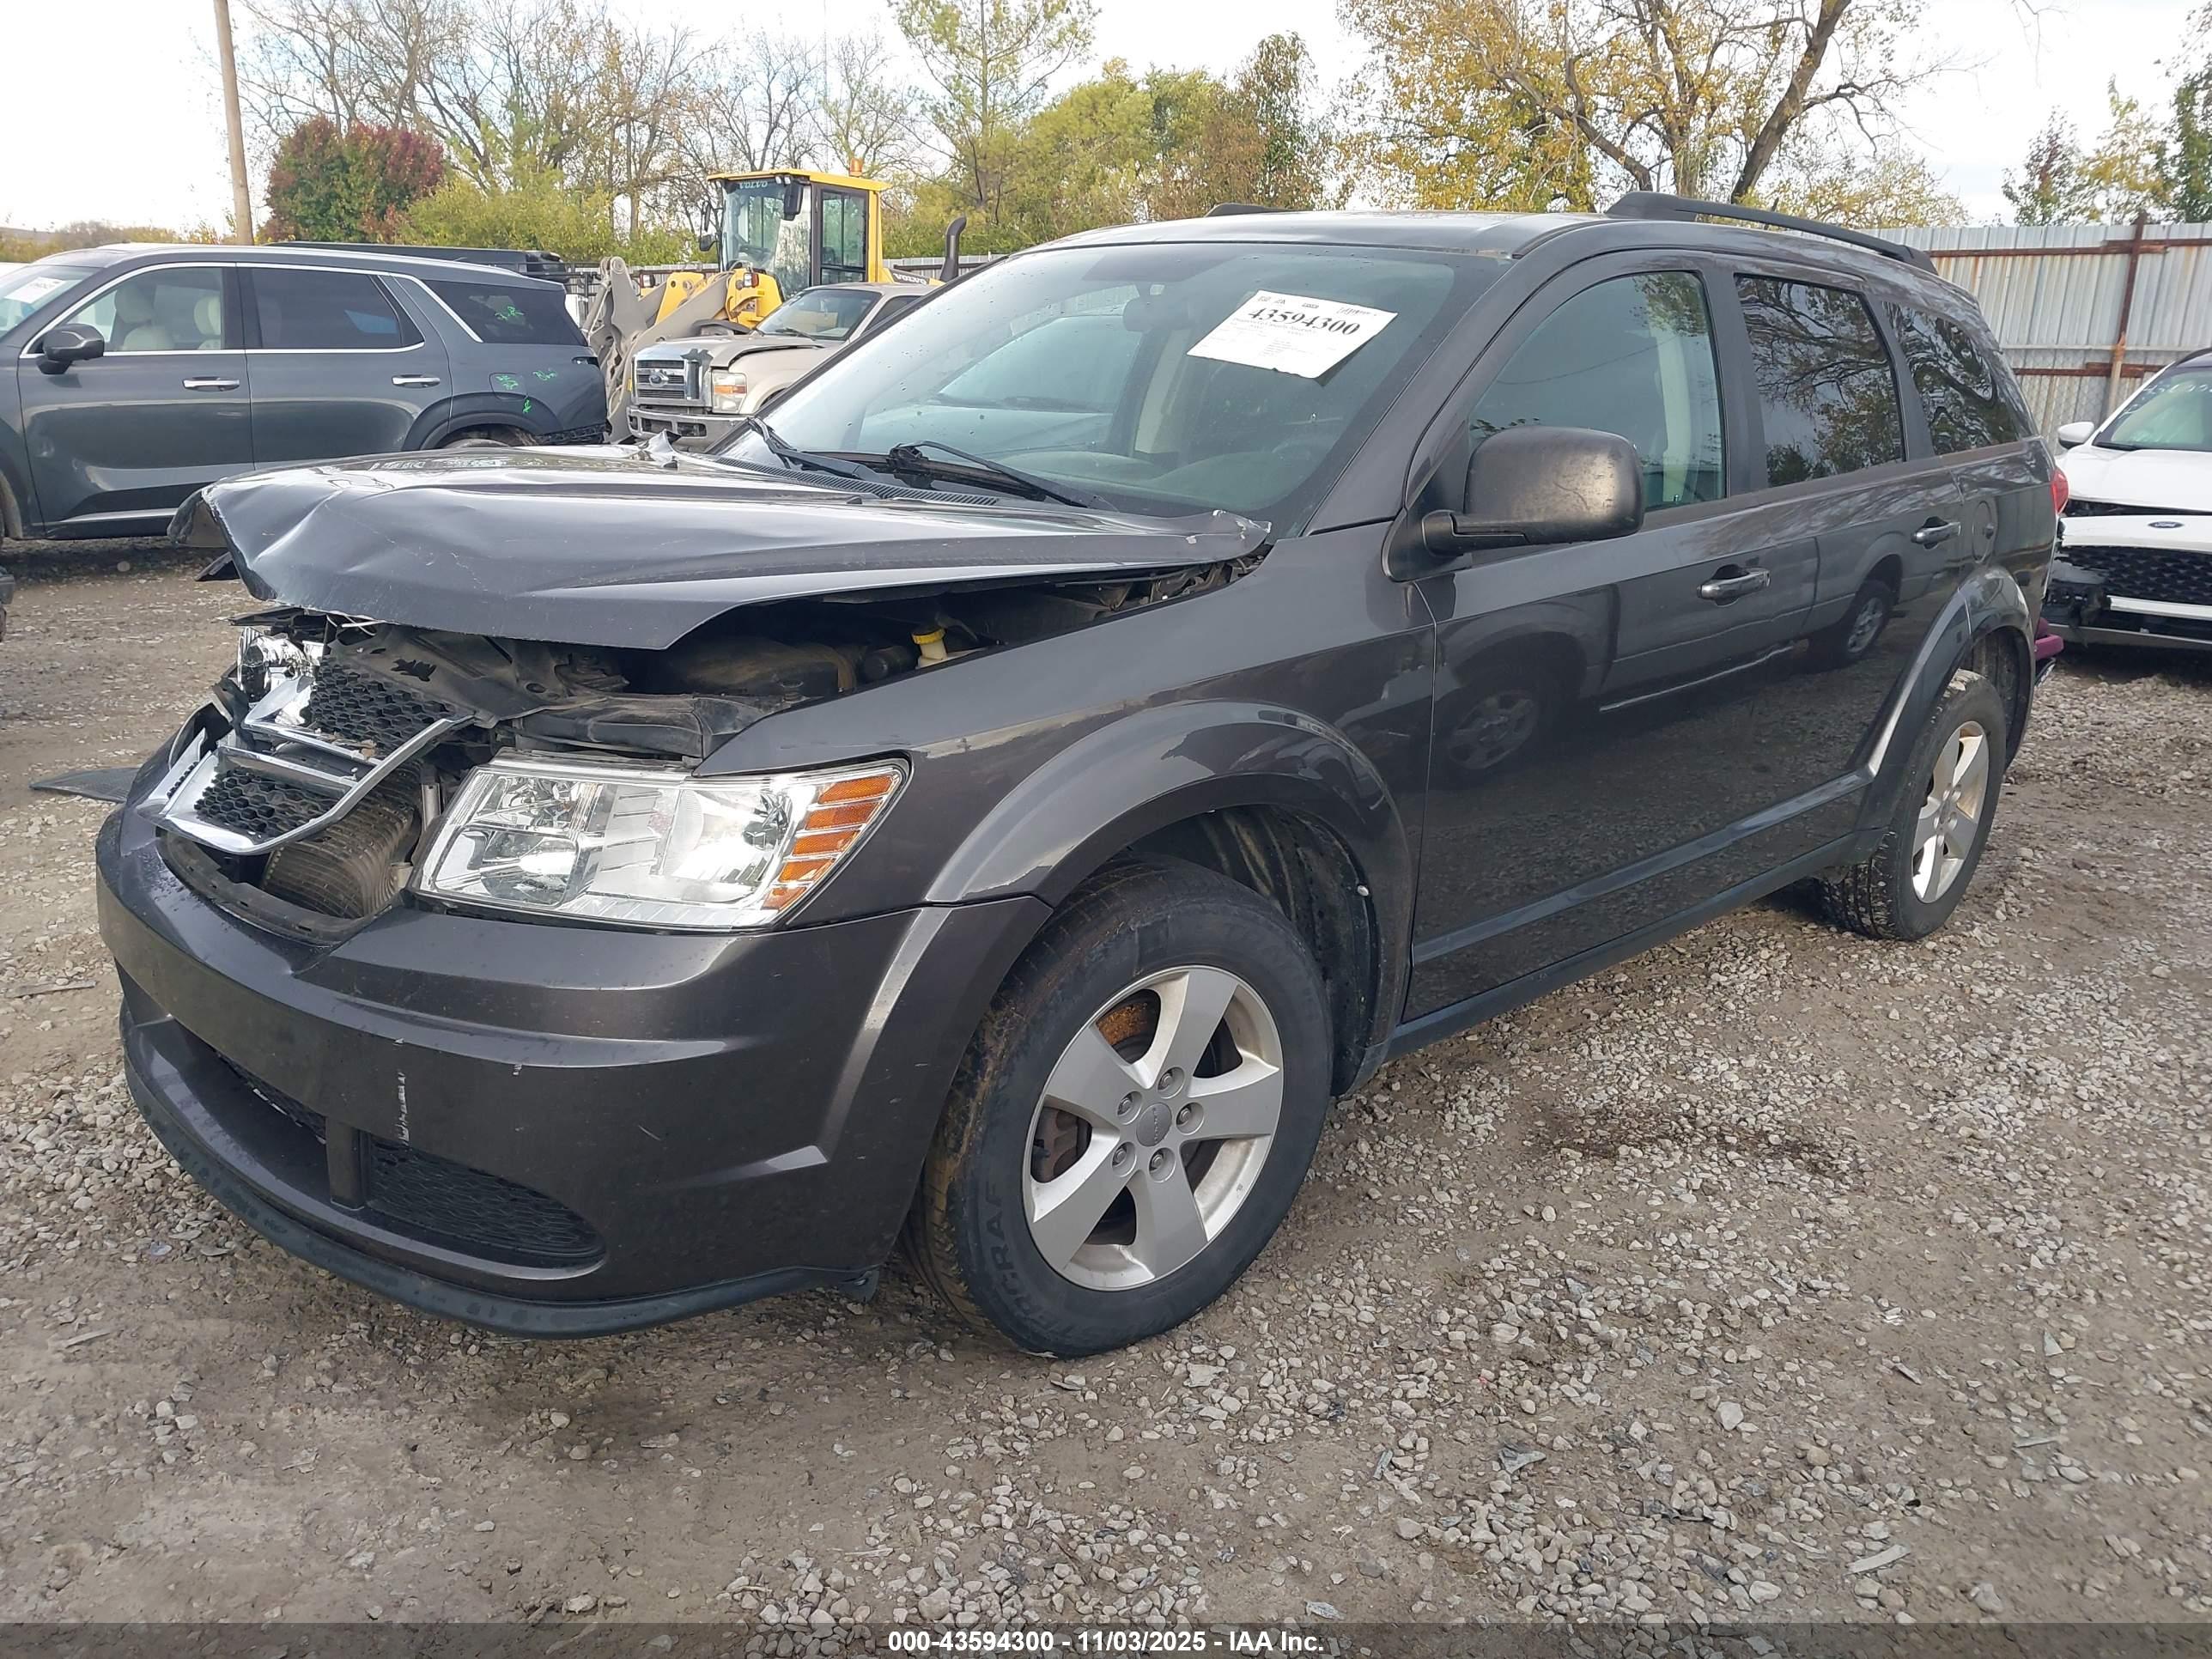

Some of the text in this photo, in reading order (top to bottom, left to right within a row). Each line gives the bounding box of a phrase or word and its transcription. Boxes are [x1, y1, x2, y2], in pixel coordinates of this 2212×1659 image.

[739, 180, 769, 189] VOLVO
[893, 272, 928, 285] VOLVO
[1248, 307, 1361, 336] 43594300
